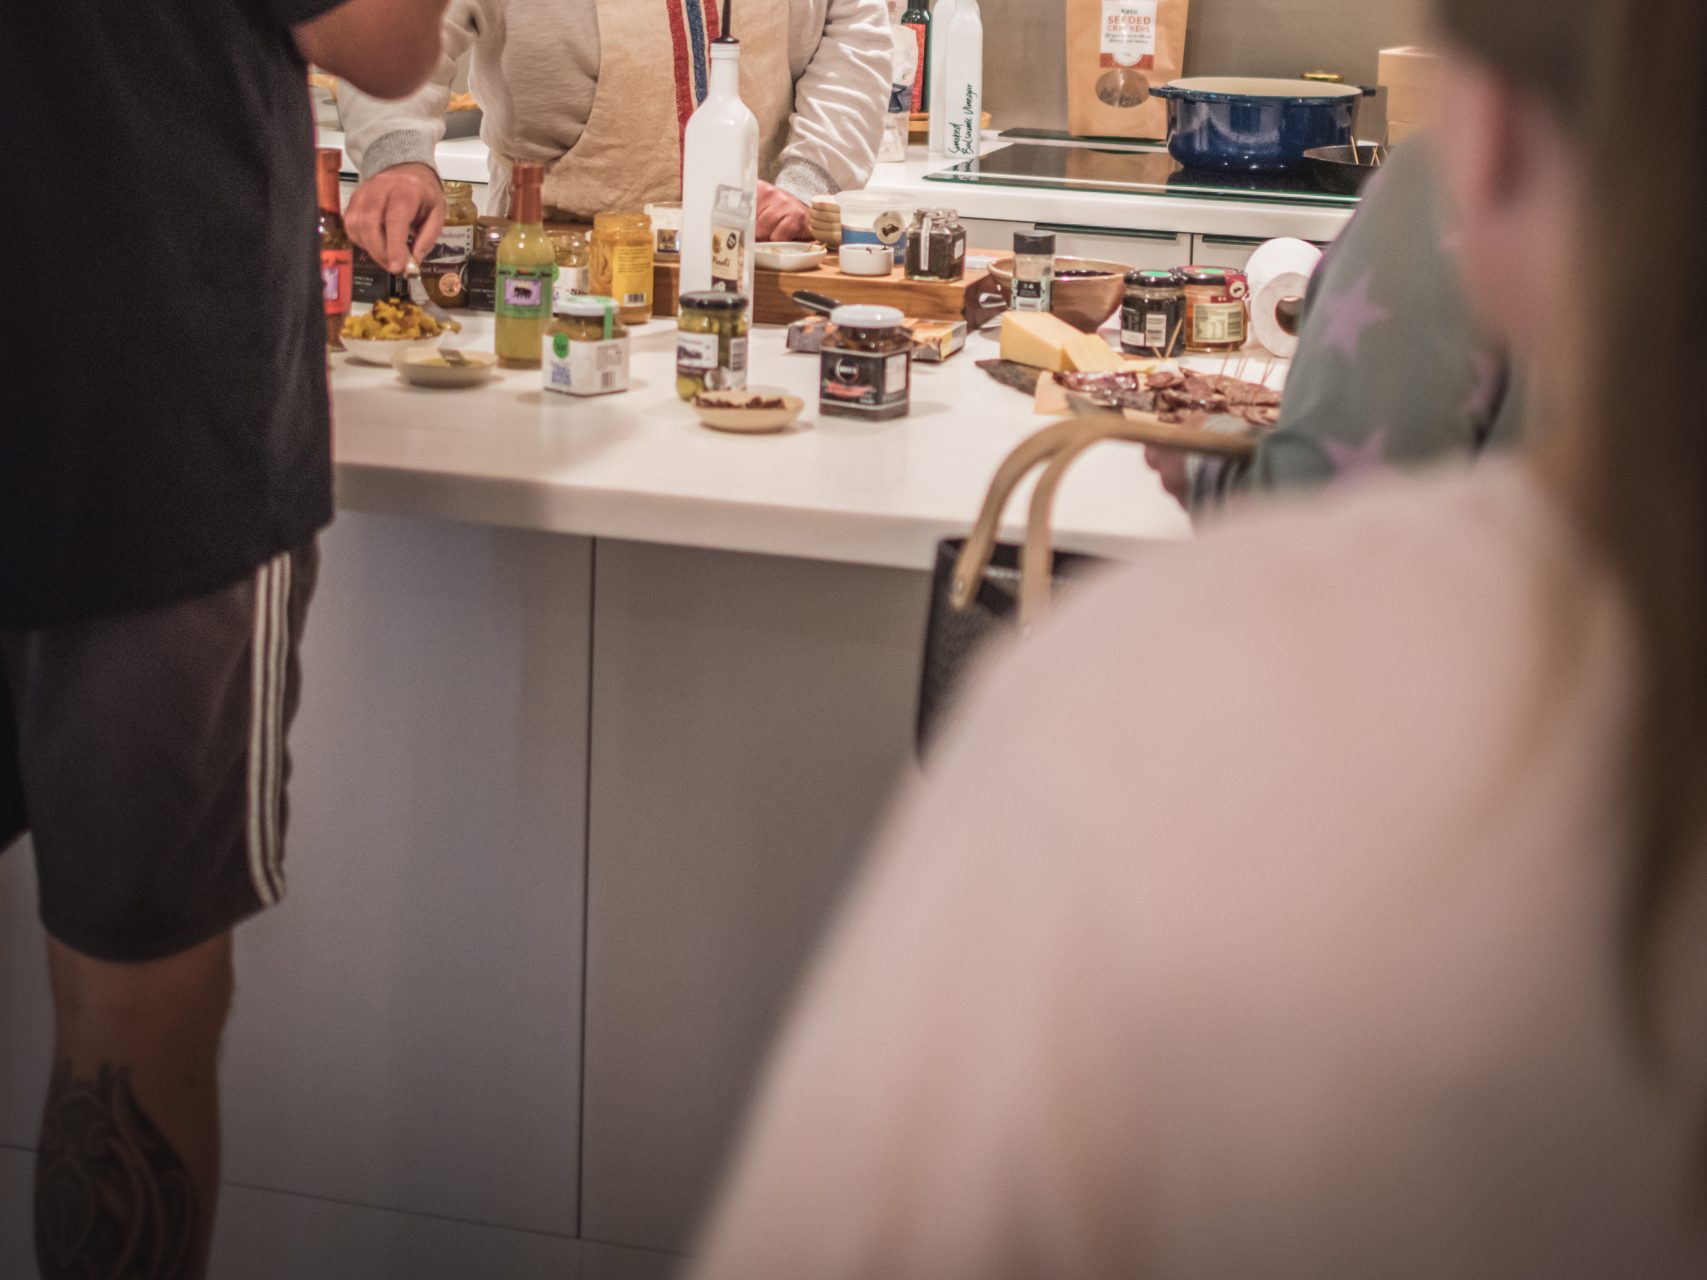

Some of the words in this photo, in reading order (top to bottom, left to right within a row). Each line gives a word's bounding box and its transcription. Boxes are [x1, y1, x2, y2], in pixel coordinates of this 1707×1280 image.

[1108, 16, 1151, 25] SEEDED
[1107, 25, 1151, 33] CRACKERS
[962, 83, 978, 115] Vinegar
